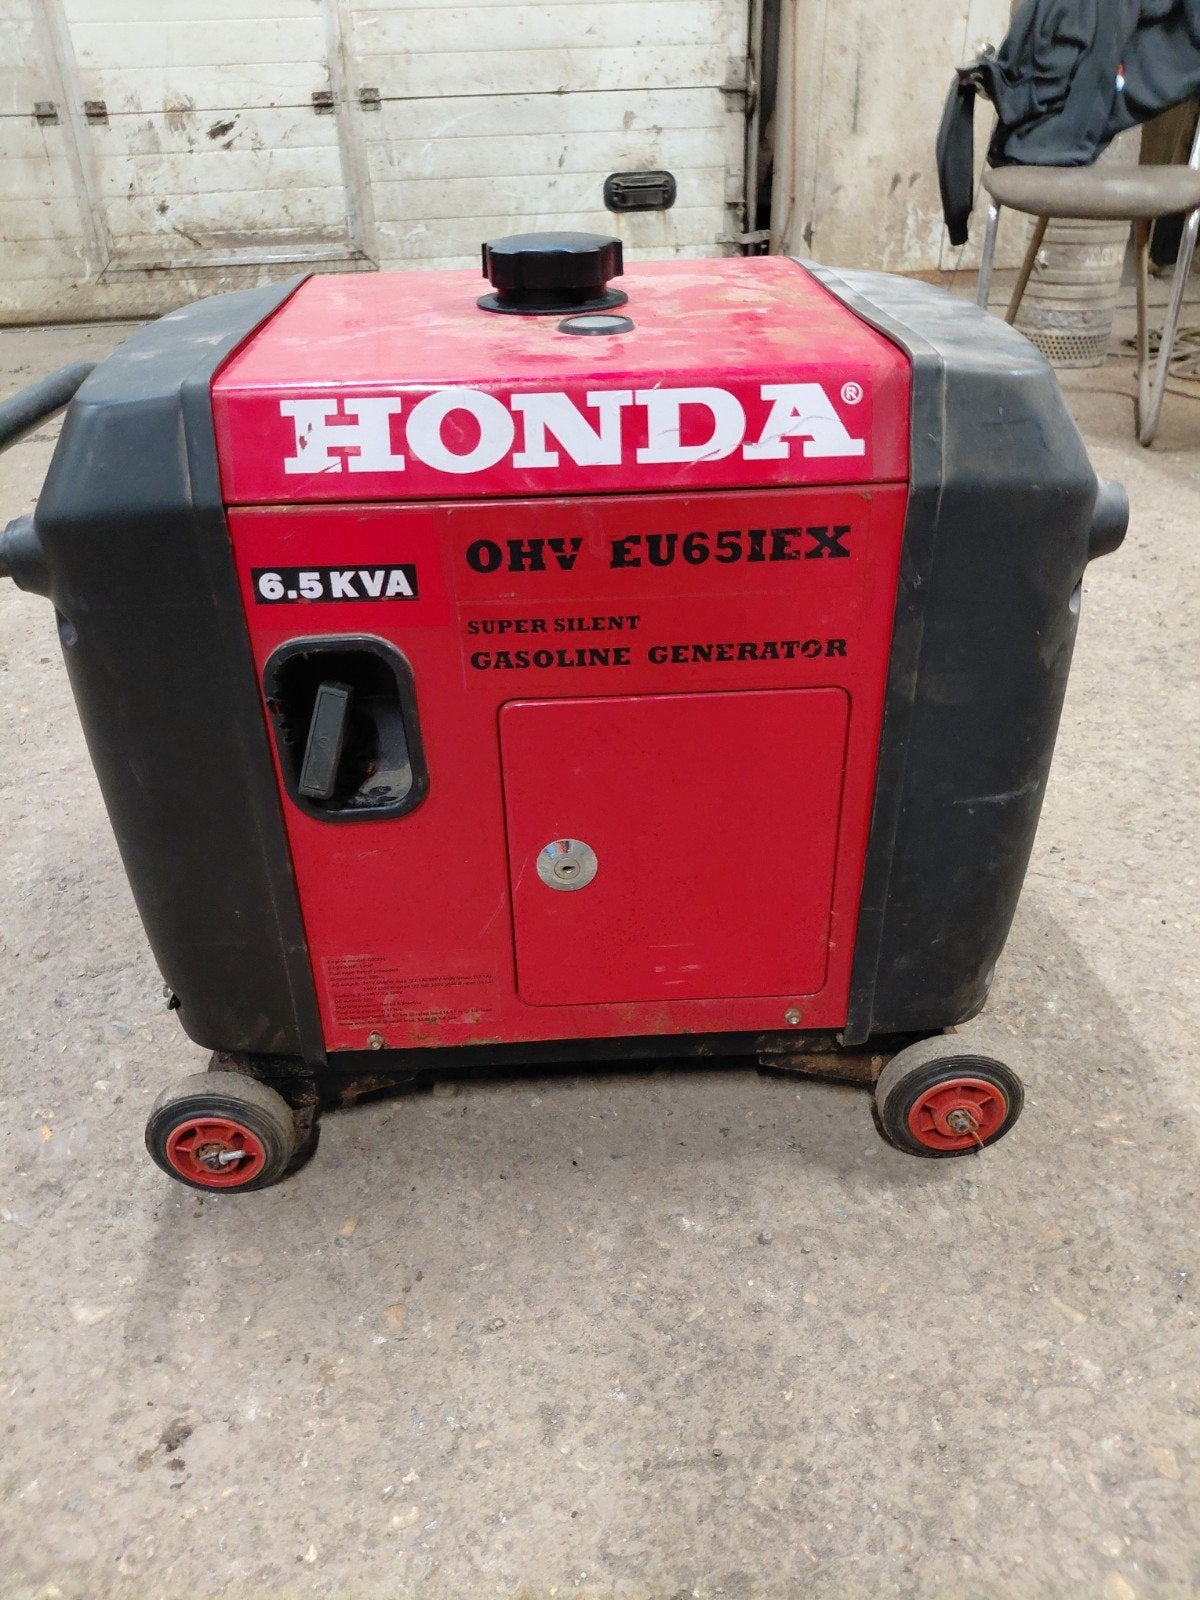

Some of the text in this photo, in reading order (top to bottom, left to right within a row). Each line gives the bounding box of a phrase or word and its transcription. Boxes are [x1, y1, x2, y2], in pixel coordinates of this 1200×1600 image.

[280, 383, 865, 474] HONDA
[466, 537, 583, 573] OHV
[468, 616, 639, 634] SUPER SILENT
[471, 639, 846, 670] GASOLINE GENERATOR
